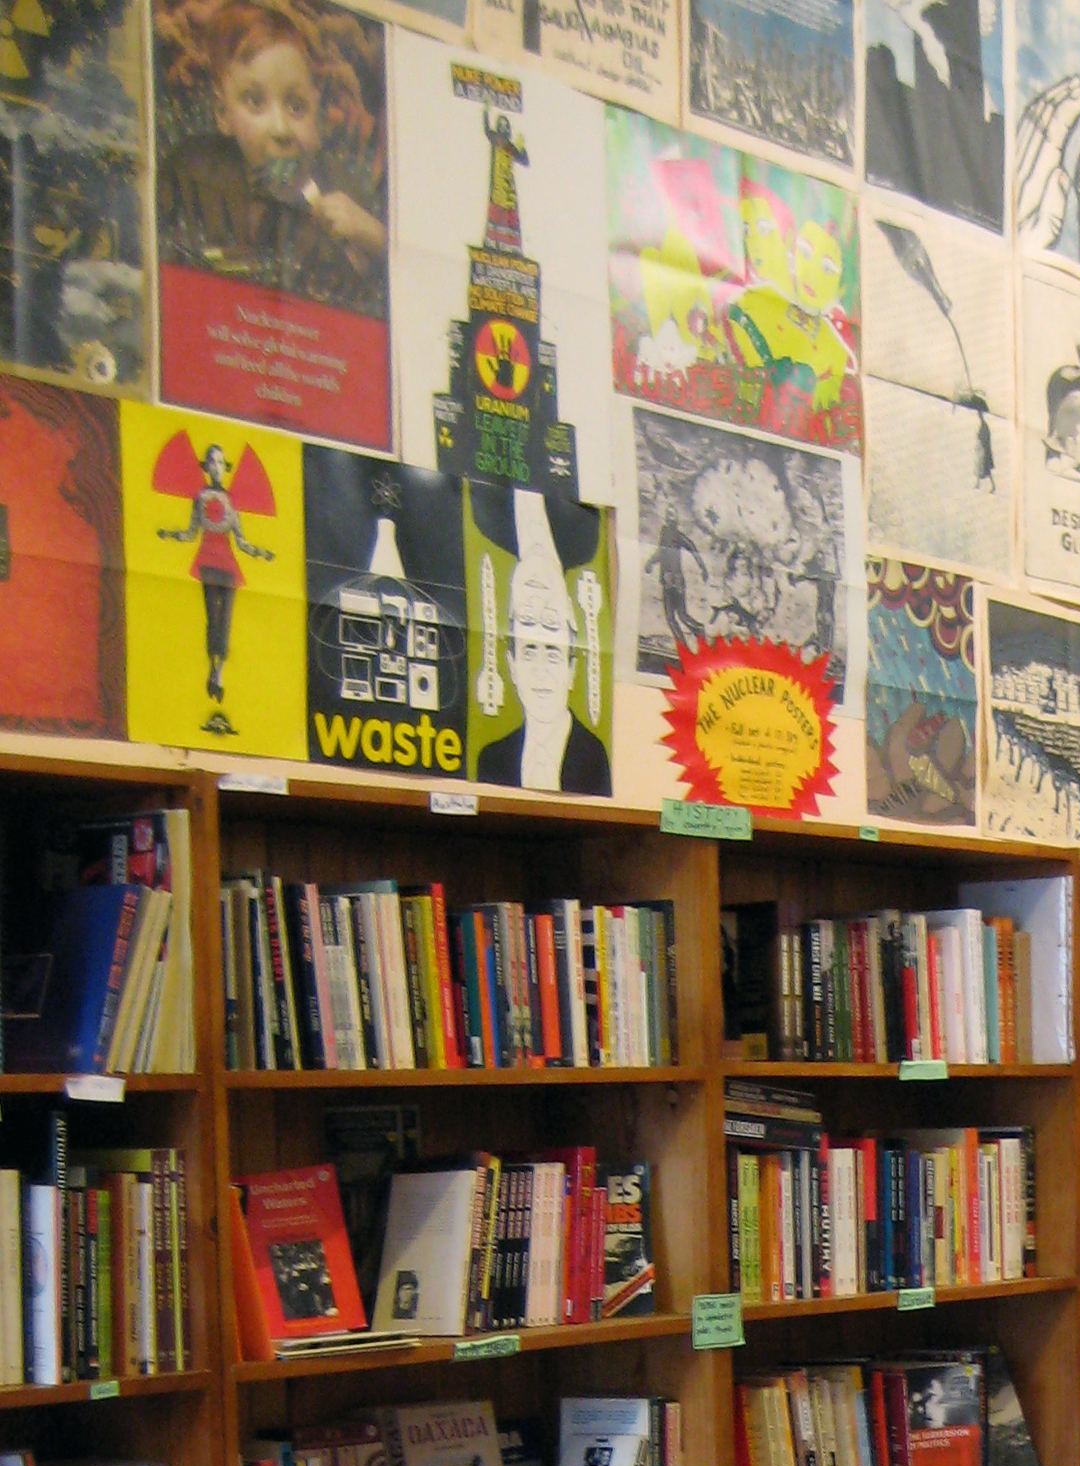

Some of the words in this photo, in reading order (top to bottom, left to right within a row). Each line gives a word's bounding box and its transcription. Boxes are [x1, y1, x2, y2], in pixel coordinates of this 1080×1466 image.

[719, 675, 775, 710] NUCLEAR
[313, 711, 463, 772] waste
[821, 1204, 831, 1272] MUTINY
[407, 1414, 488, 1445] OAXACA
